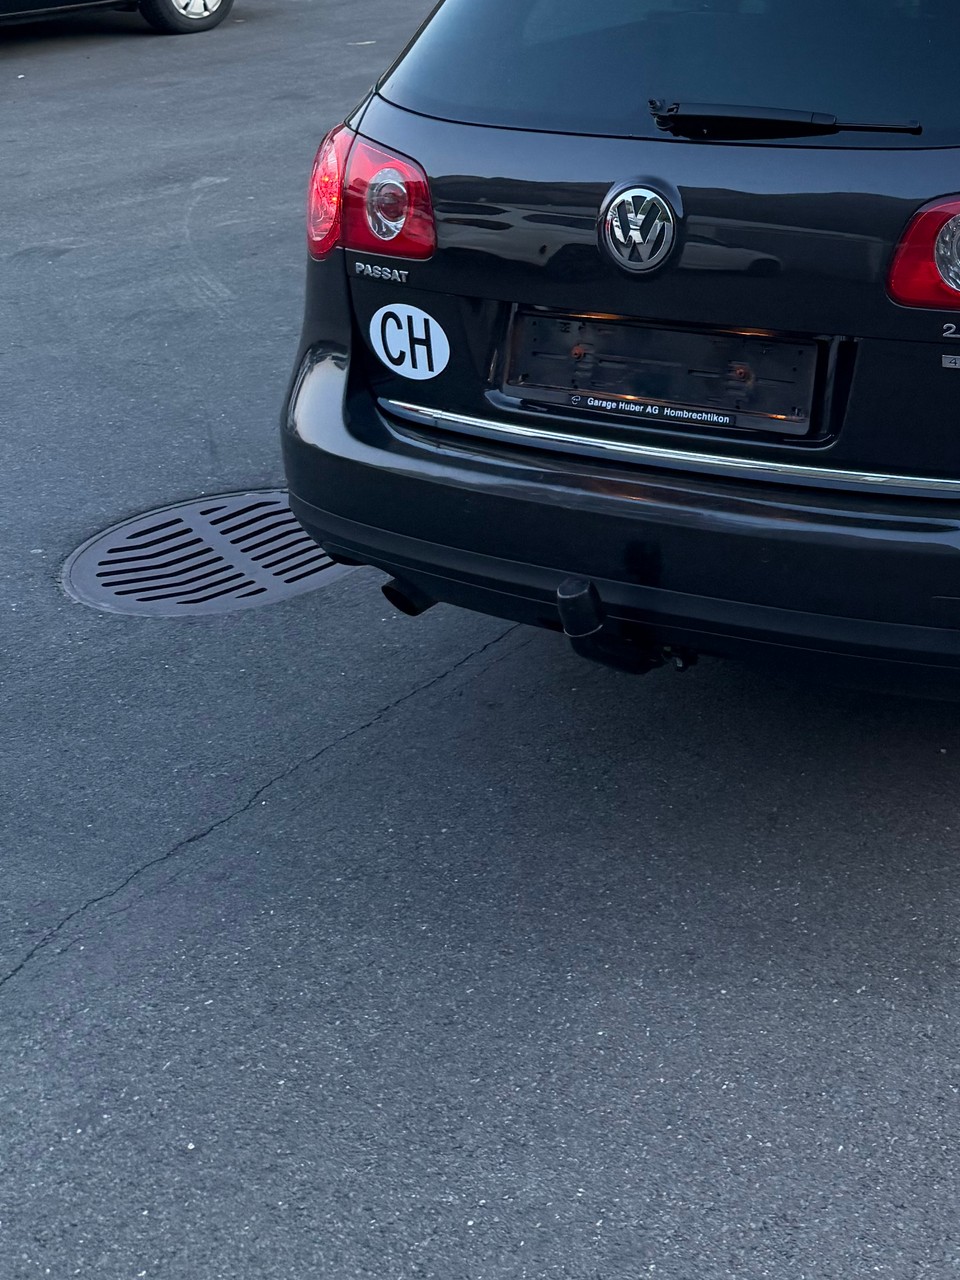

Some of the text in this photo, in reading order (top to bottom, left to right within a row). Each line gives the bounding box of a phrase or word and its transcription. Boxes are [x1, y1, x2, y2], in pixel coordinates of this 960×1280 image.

[355, 262, 409, 283] PASSAT
[381, 311, 434, 372] CH
[587, 397, 730, 424] Garage Huber AG Hombrechtikon
